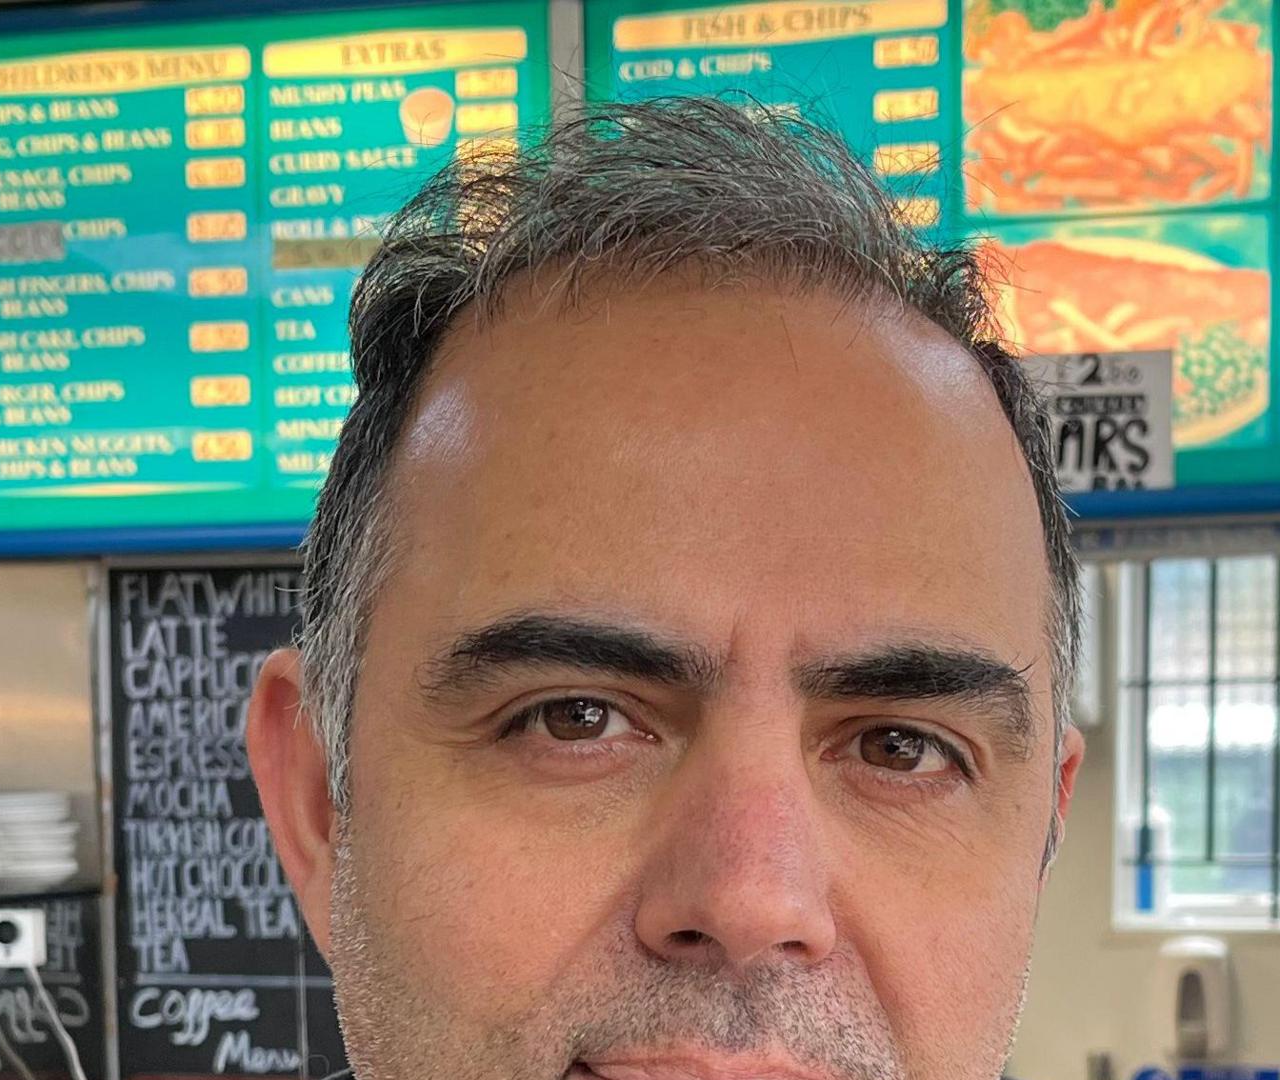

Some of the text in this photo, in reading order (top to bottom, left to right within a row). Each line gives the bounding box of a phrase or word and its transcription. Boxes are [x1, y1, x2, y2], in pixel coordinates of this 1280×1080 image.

[683, 15, 745, 39] FISH
[783, 5, 871, 32] CHIPS
[341, 38, 446, 66] EXTRAS
[620, 52, 771, 82] COD & CHIPS
[1058, 414, 1151, 474] ARS
[123, 617, 228, 659] LATTE
[128, 737, 252, 780] ESPRESS
[127, 779, 233, 818] MOCHA
[131, 855, 292, 898] HOT CHOCOL
[132, 898, 238, 941] HERBAL
[239, 896, 298, 939] TEA
[137, 937, 190, 973] TEA
[132, 986, 261, 1046] Coffee
[213, 1029, 302, 1074] Menu
